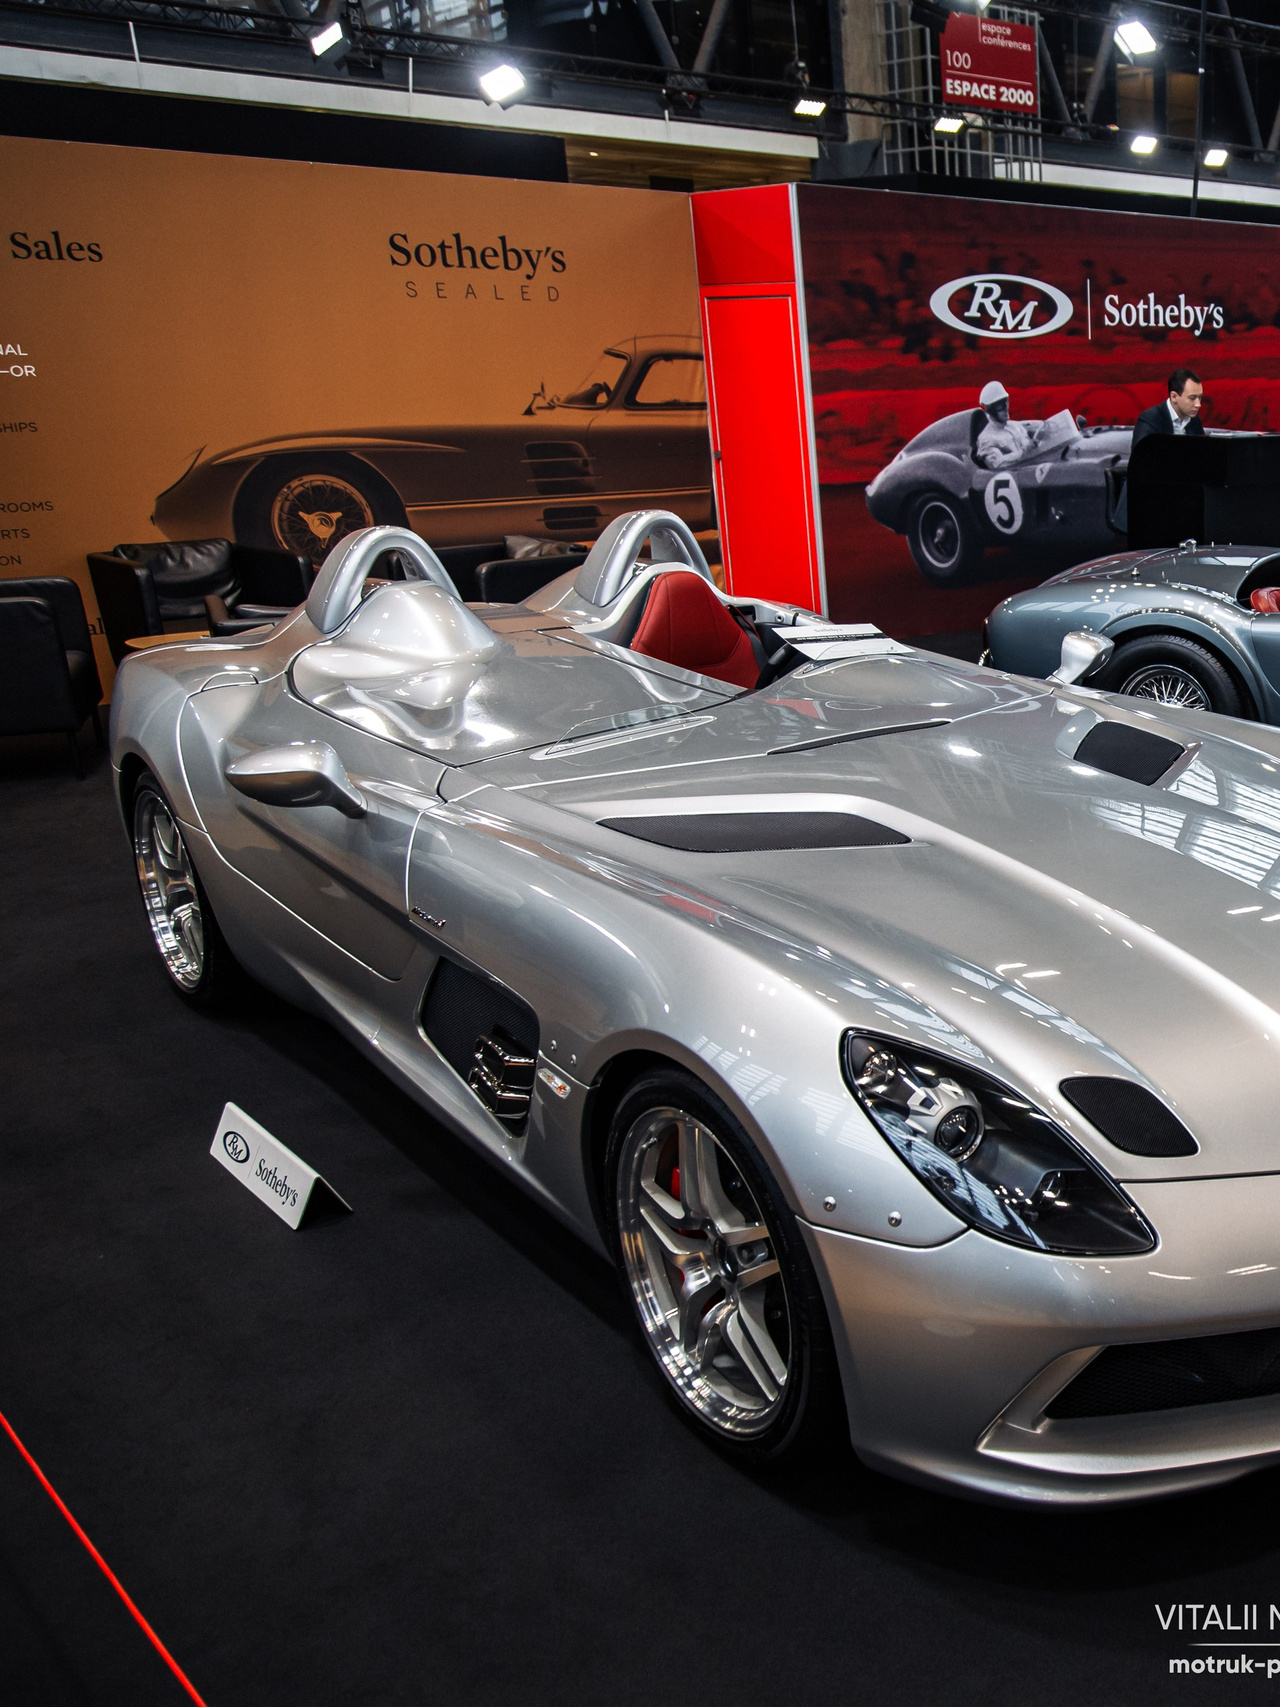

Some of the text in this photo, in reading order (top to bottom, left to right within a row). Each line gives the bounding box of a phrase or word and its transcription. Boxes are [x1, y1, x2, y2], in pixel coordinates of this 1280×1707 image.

[981, 22, 1011, 36] espace
[982, 35, 1031, 52] conférences
[945, 49, 972, 70] 100
[945, 78, 1034, 106] ESPACE 2000
[9, 230, 103, 262] Sales
[388, 232, 567, 280] Sotheby's
[405, 280, 560, 302] SEALED
[963, 281, 1224, 337] RM Sotheby's
[0, 422, 38, 433] HIPS
[993, 479, 1016, 530] 5
[255, 1158, 299, 1207] Sotheby's
